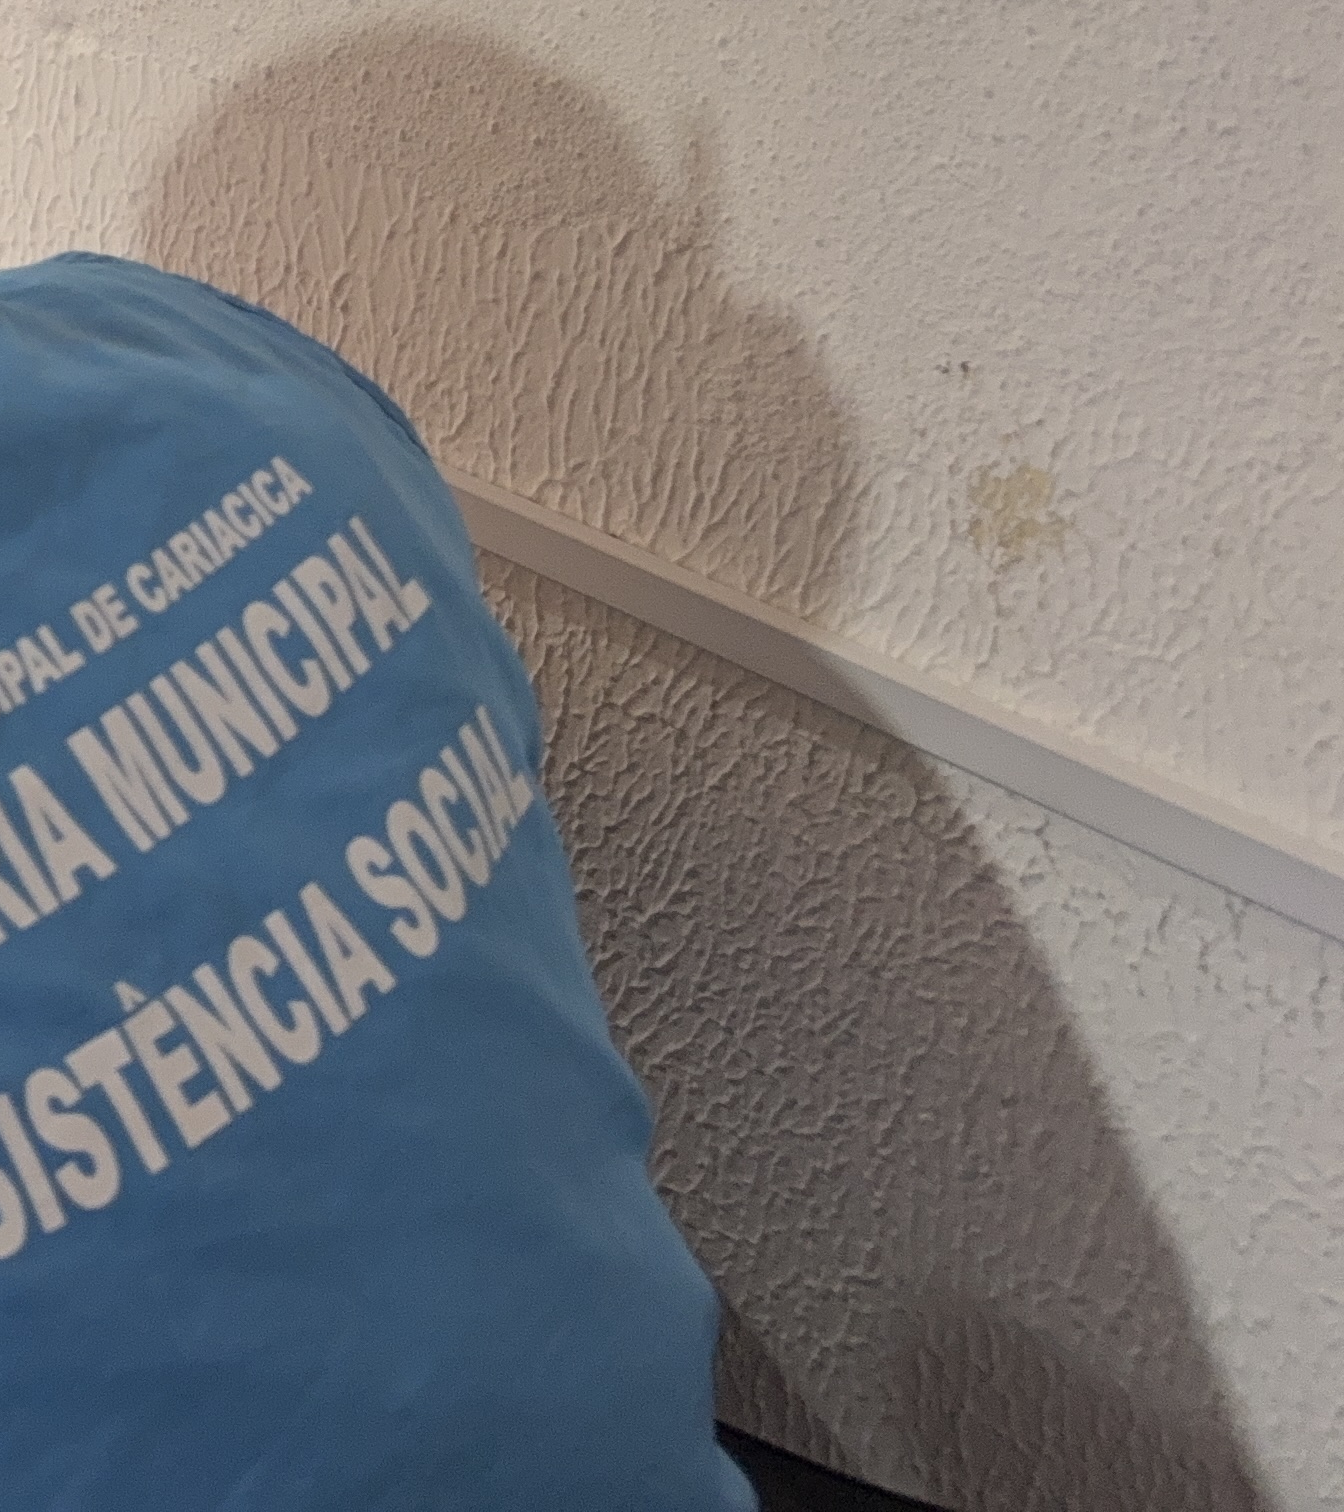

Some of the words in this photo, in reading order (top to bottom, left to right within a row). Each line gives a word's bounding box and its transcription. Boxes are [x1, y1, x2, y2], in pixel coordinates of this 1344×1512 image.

[68, 583, 139, 656] DE
[124, 454, 313, 616] CARIACICA
[66, 515, 432, 855] MUNICIPAL
[345, 705, 536, 960] SOCIAL
